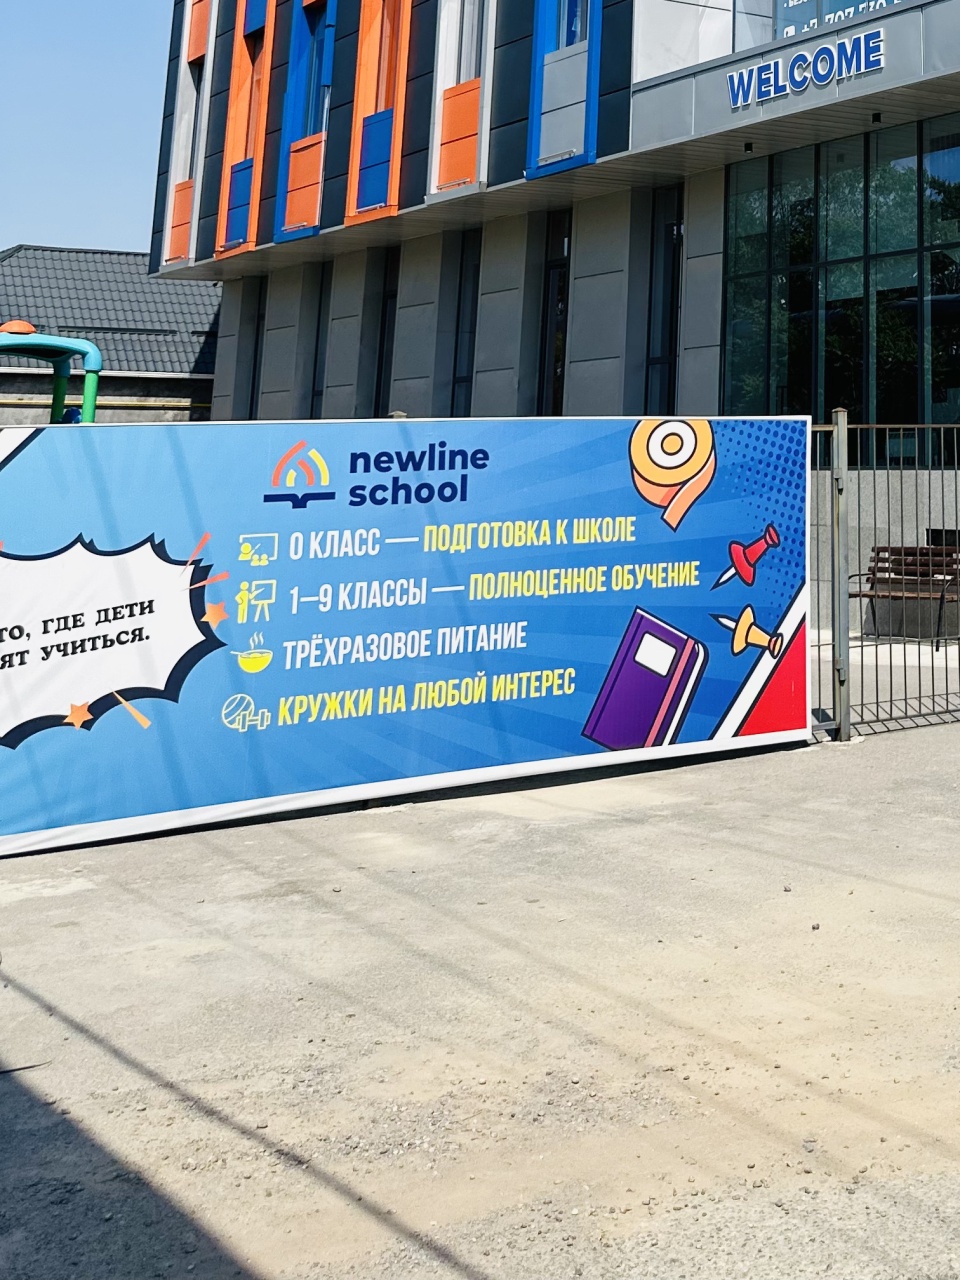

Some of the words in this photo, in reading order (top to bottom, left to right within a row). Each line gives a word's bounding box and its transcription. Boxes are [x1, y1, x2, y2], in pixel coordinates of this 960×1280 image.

[727, 28, 884, 108] WELCOME
[349, 440, 490, 473] newline
[349, 474, 467, 507] school
[309, 528, 380, 559] КЛАСС
[423, 521, 551, 554] ПОДГОТОВКА
[556, 519, 570, 545] К
[573, 516, 636, 544] ШКОЛЕ
[338, 578, 428, 612] КЛАССЫ
[469, 566, 608, 602] ПОЛНОЦЕННОЕ
[611, 561, 700, 590] ОБУЧЕНИЕ
[42, 612, 85, 634] ГДЕ
[95, 599, 155, 627] ДЕТИ
[40, 627, 150, 661] УЧИТЬСЯ.
[283, 630, 432, 670] ТРЁХРАЗОВОЕ
[437, 621, 528, 656] ПИТАНИЕ
[278, 687, 373, 726] КРУЖКИ
[378, 685, 406, 715] НА
[411, 671, 487, 711] ЛЮБОЙ
[492, 668, 576, 702] ИНТЕРЕС
